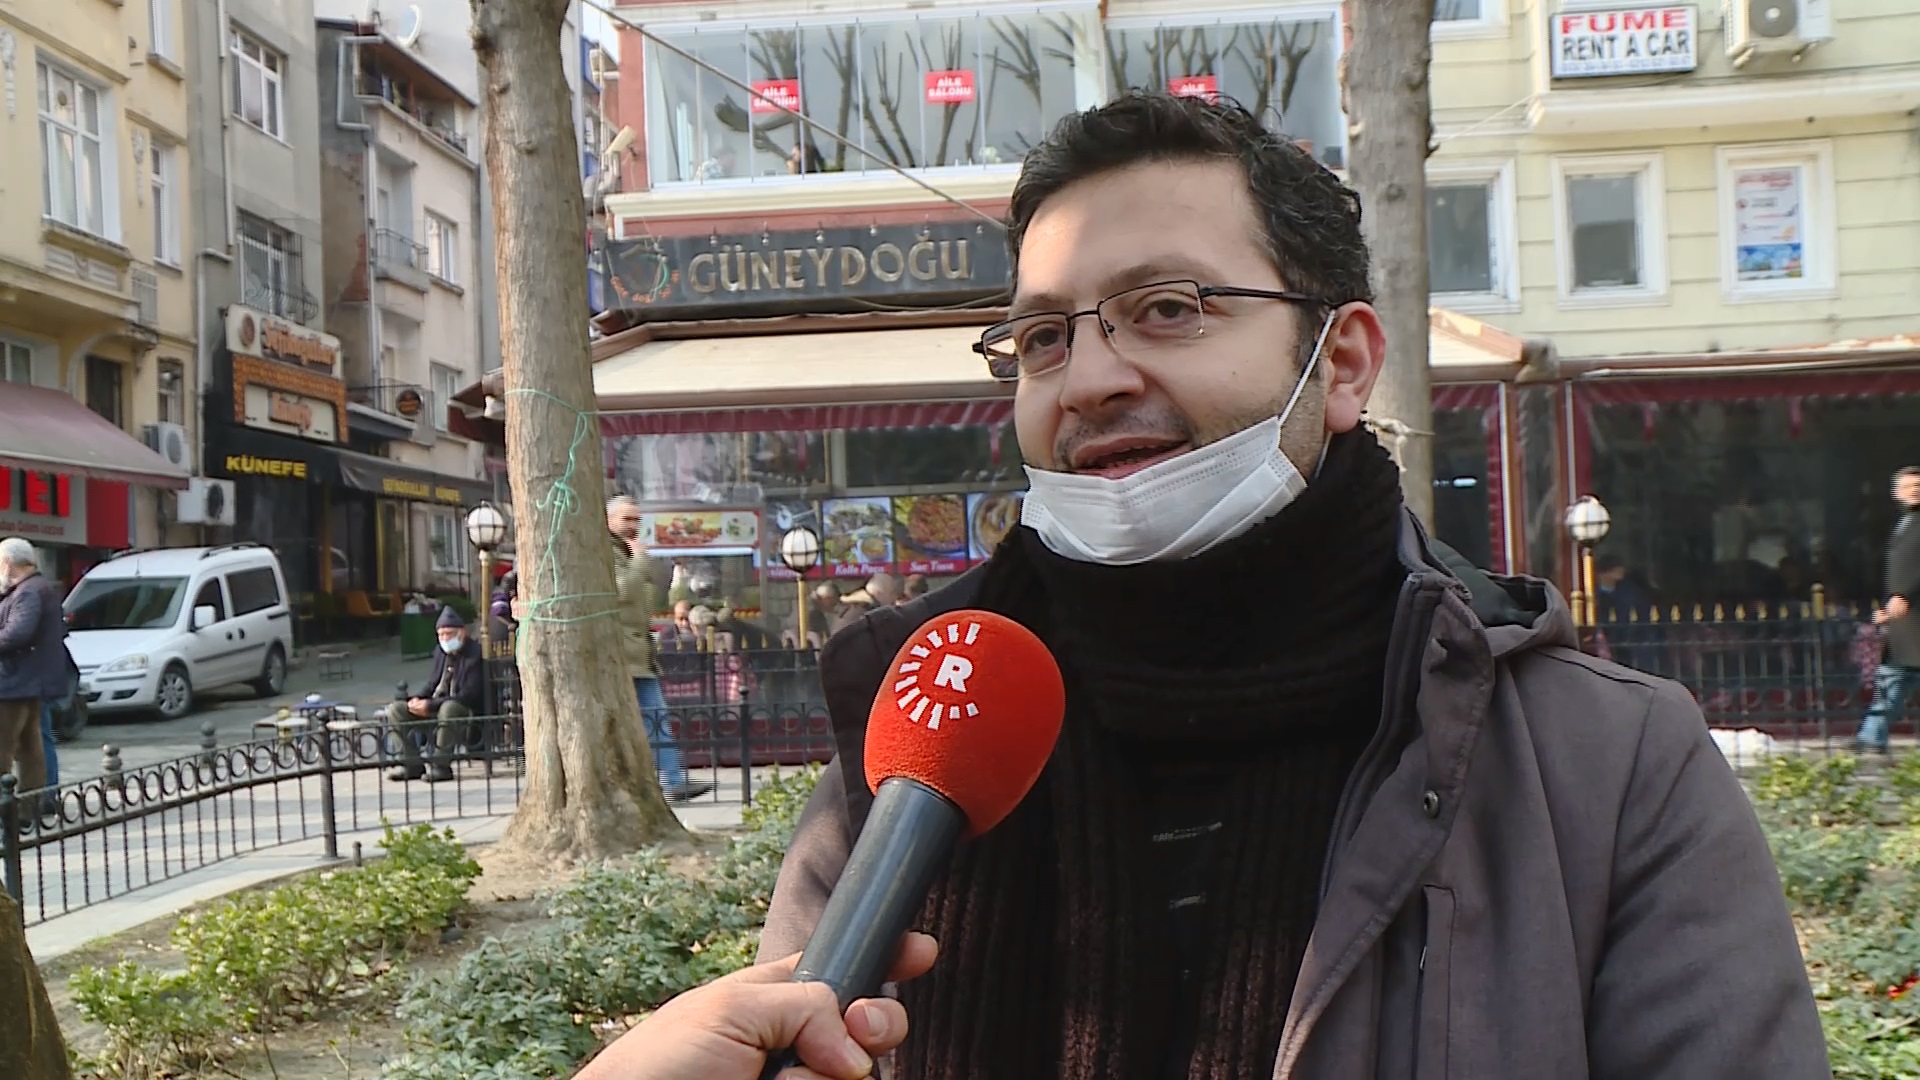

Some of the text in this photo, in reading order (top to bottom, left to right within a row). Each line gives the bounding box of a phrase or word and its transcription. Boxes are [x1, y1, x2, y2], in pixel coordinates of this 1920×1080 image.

[1561, 8, 1688, 34] FUME
[1563, 29, 1690, 60] RENT A CAR
[688, 234, 969, 294] GÜNEYDOĞU
[226, 454, 306, 478] KÜNEFE
[934, 653, 973, 693] R
